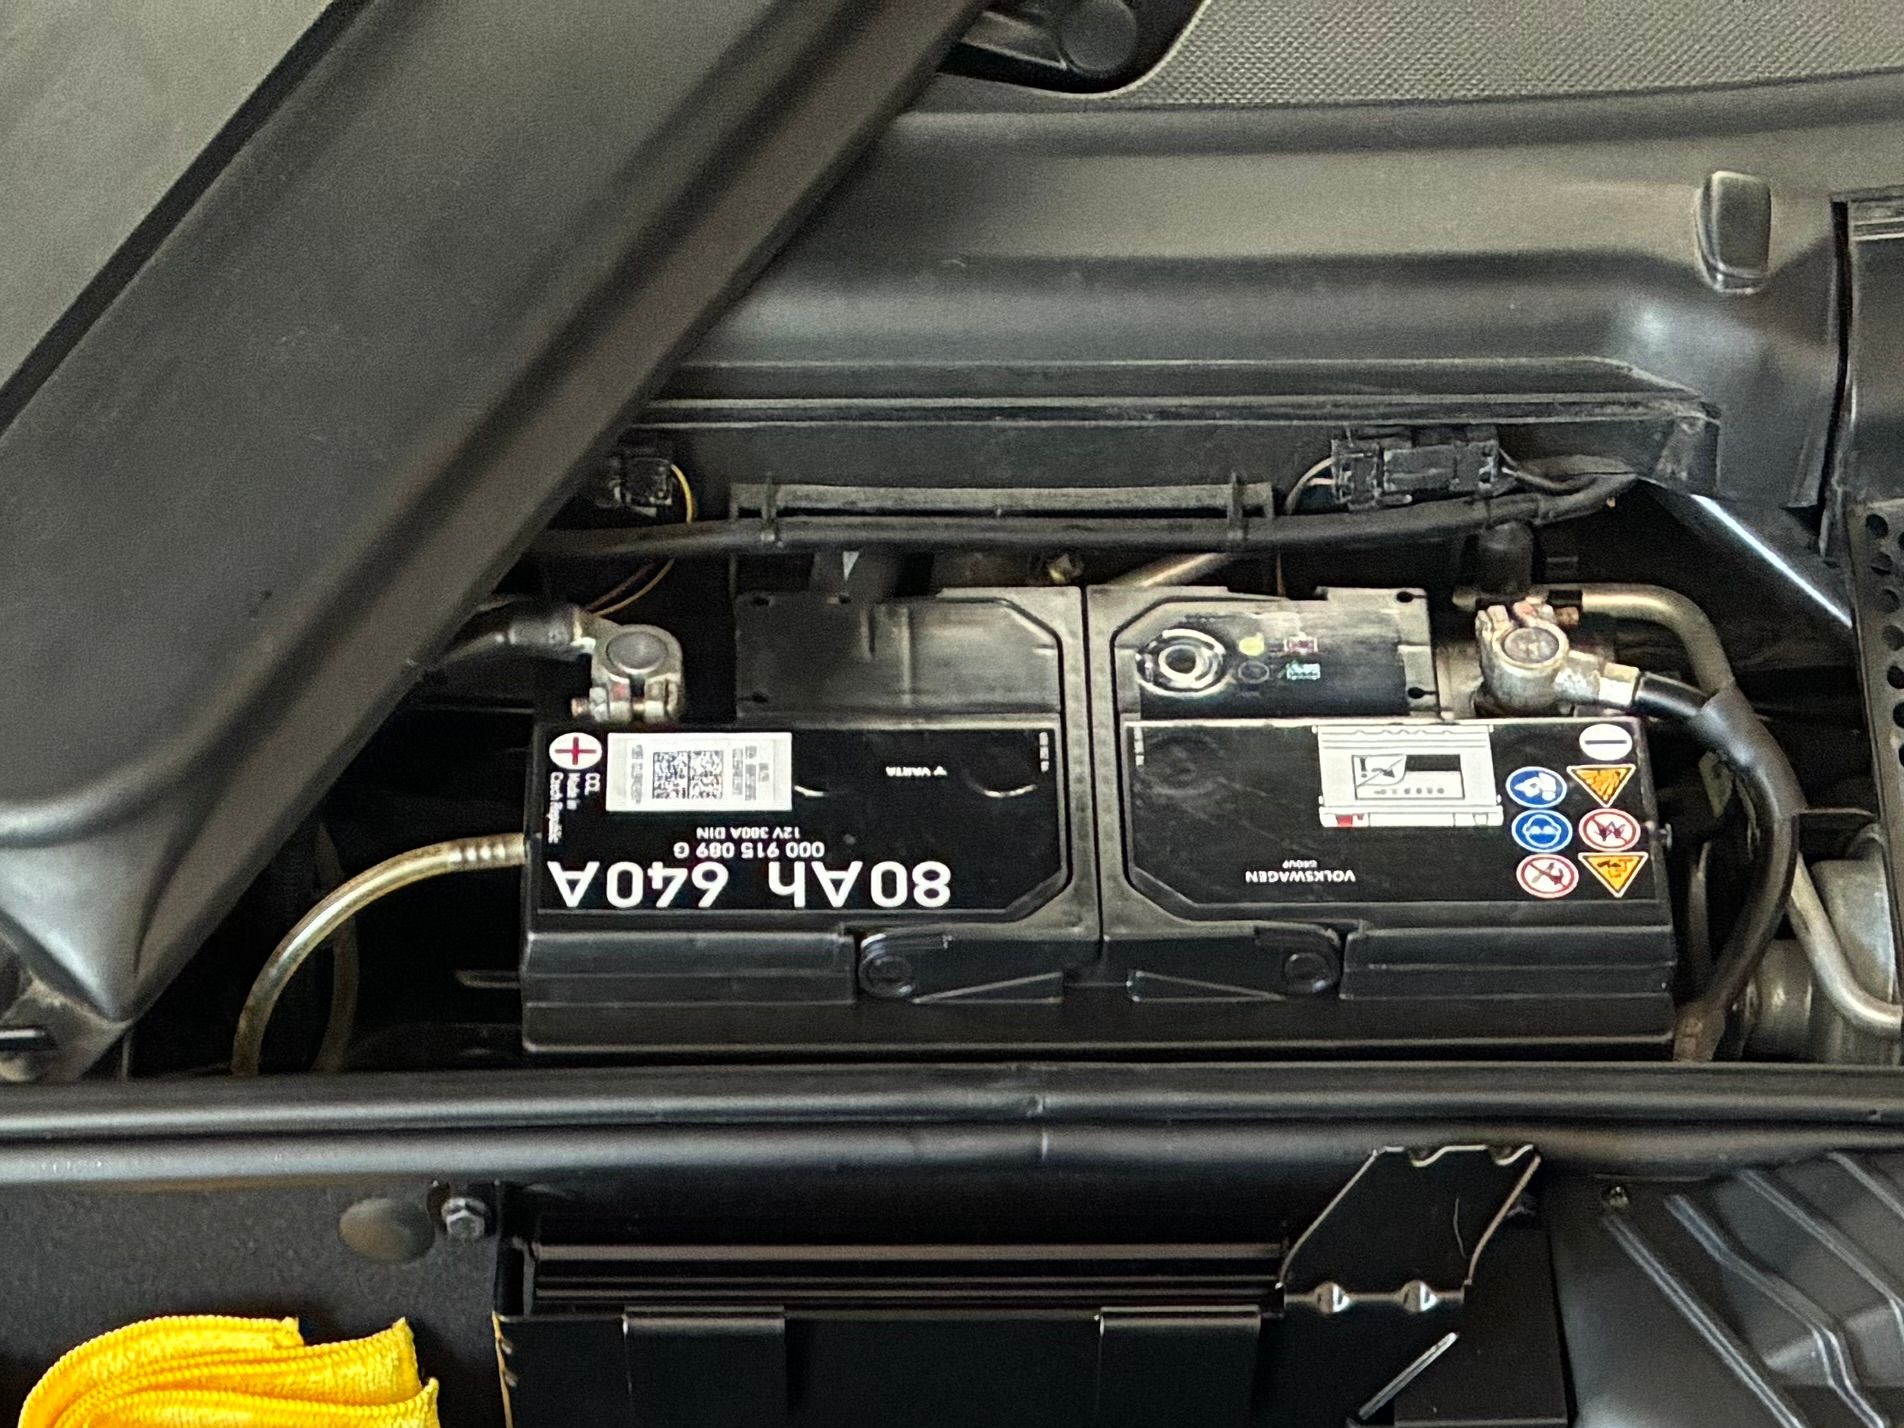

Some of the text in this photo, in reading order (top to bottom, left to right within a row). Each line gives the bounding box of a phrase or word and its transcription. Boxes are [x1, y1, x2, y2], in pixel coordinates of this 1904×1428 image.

[697, 827, 726, 840] DIN
[673, 842, 690, 859] G
[741, 842, 780, 859] 915
[786, 842, 825, 859] 000
[547, 861, 729, 908] 640A
[1245, 870, 1357, 883] VOLKSWAGEN
